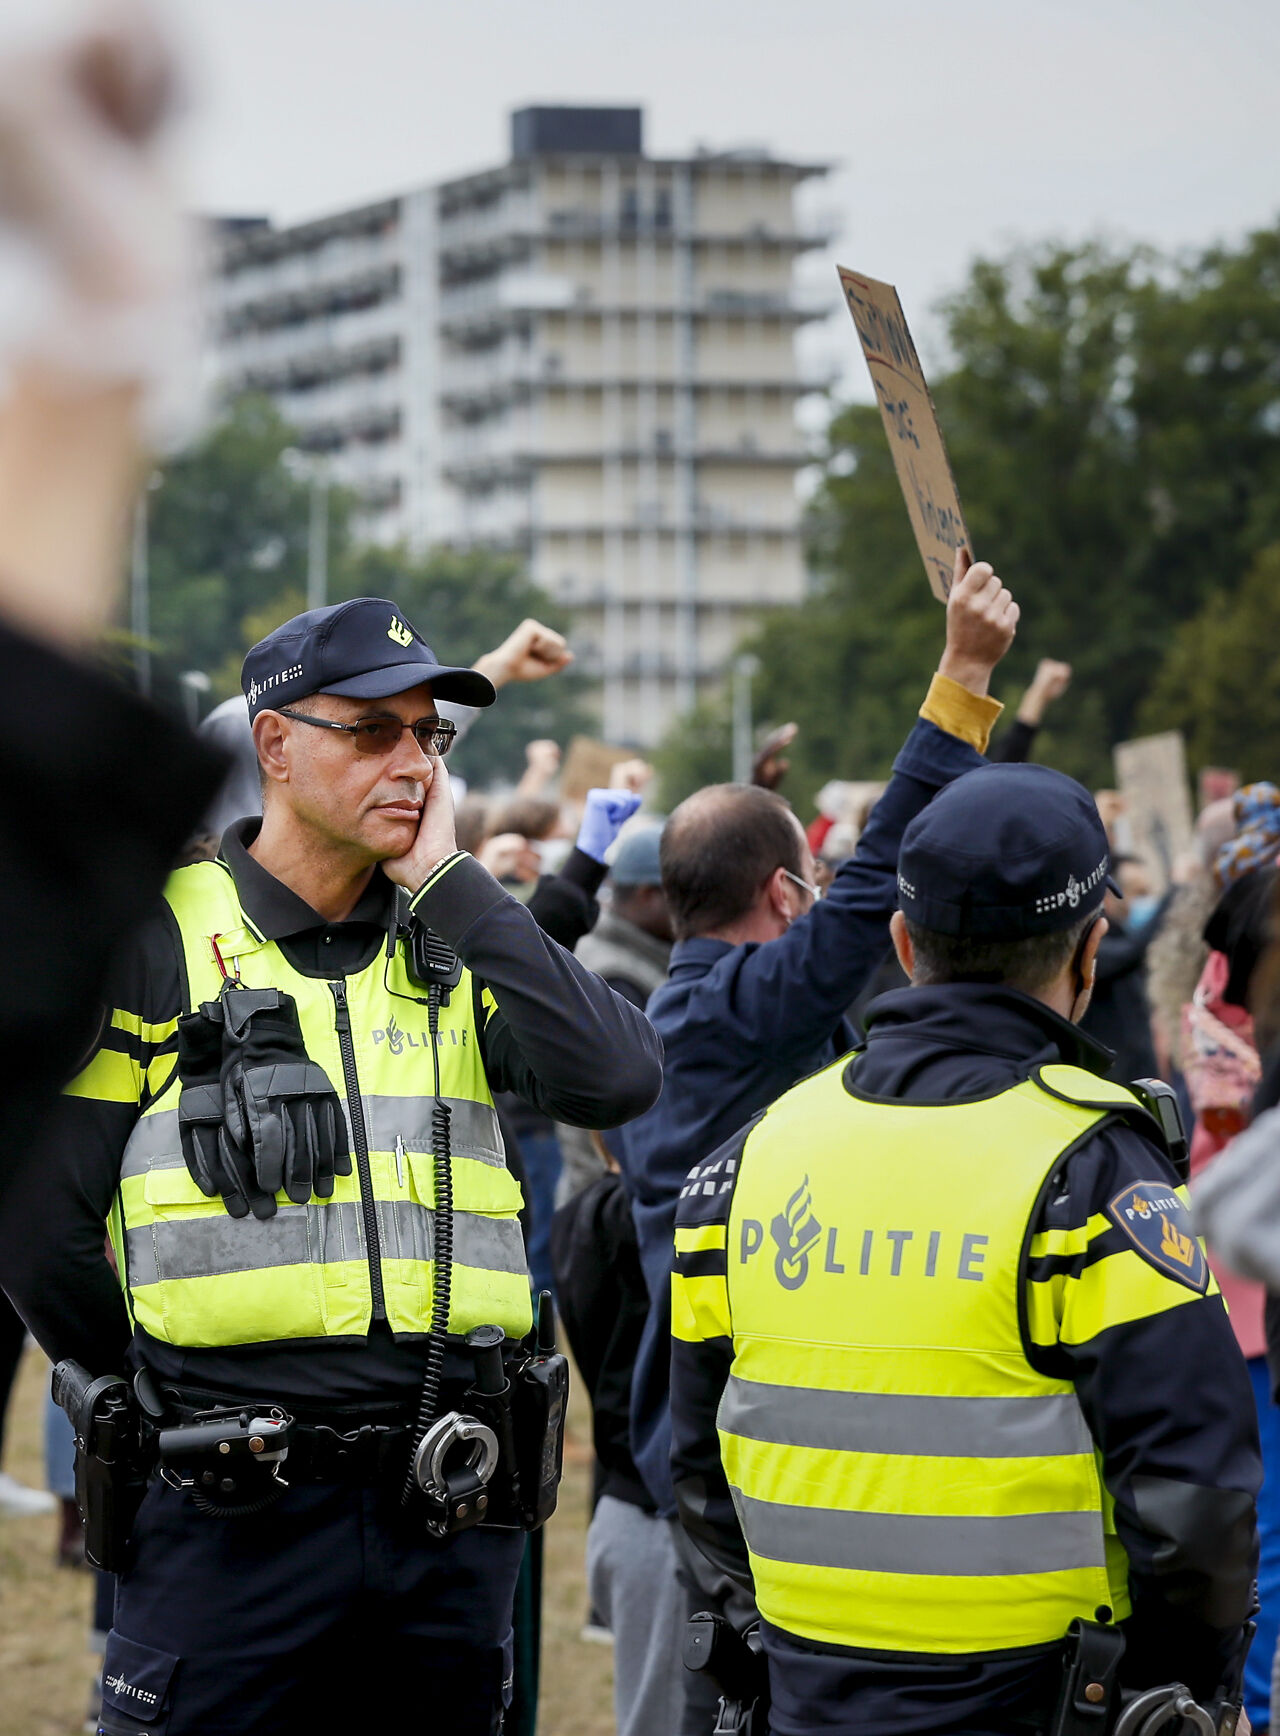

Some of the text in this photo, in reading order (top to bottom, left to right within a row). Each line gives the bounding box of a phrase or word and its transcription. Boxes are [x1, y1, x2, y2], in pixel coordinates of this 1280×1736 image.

[372, 1026, 468, 1055] POLITIE
[1124, 1197, 1180, 1220] POLITIE
[739, 1212, 989, 1291] POLITIE
